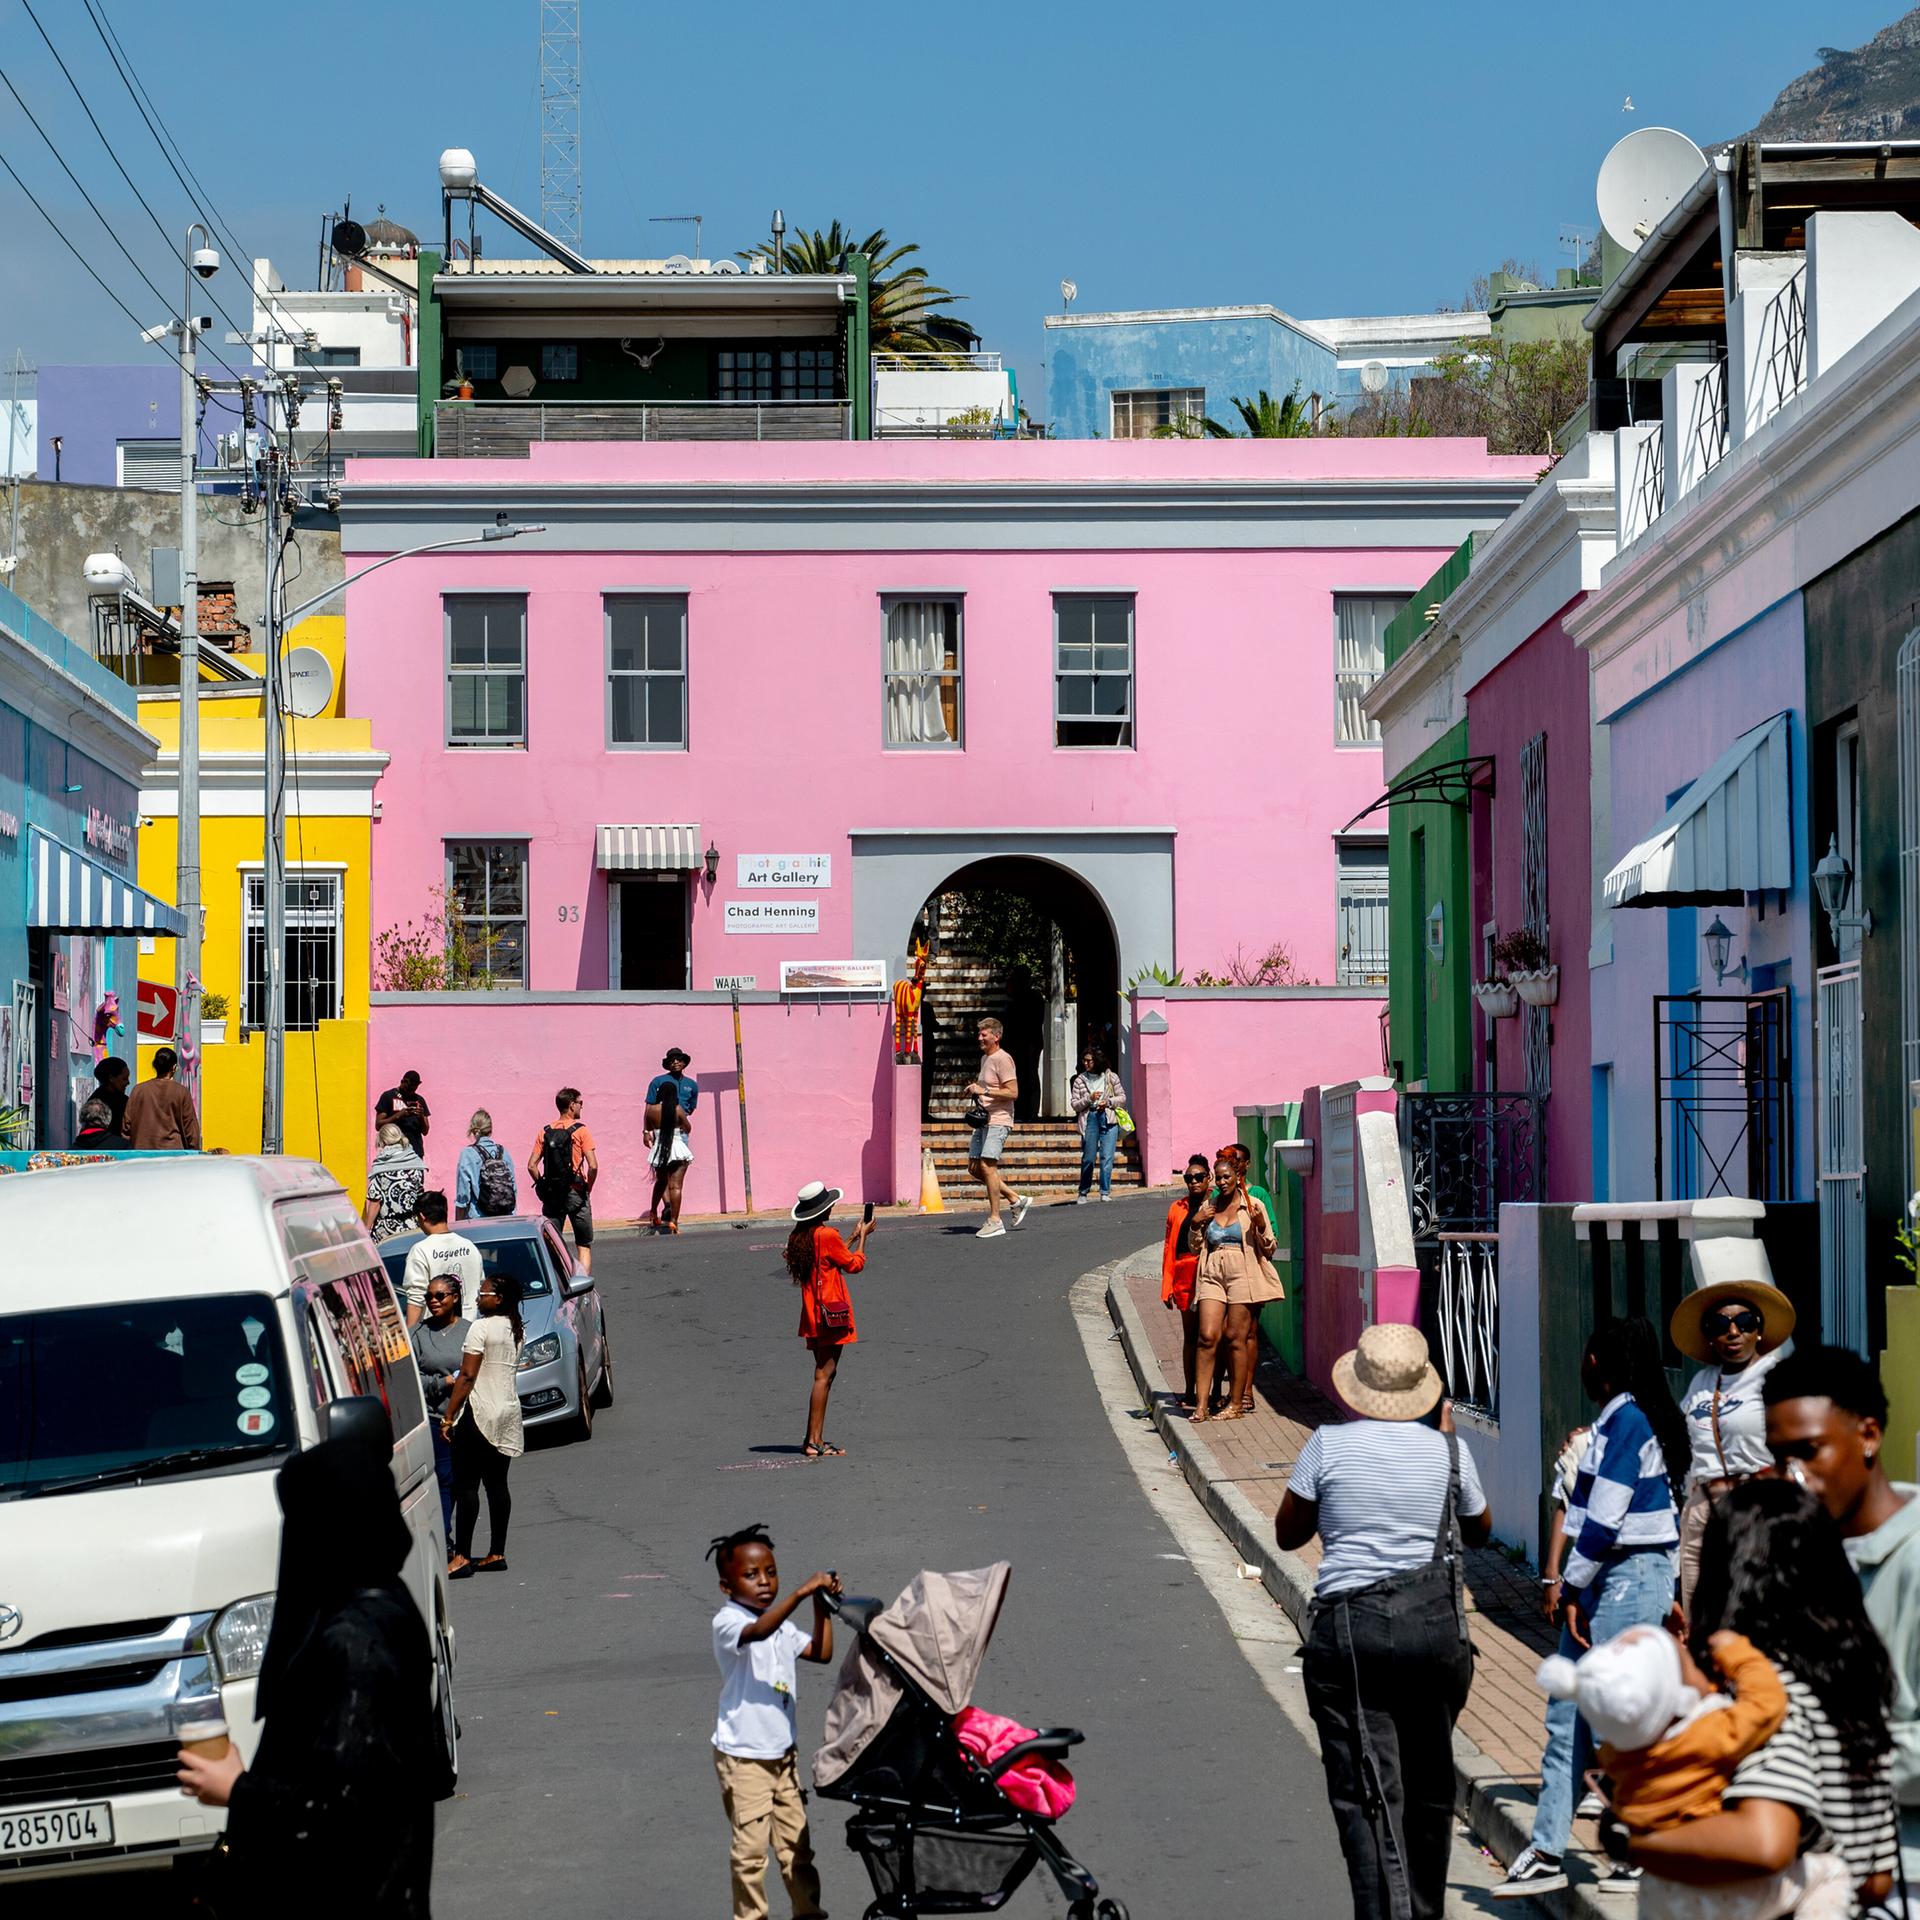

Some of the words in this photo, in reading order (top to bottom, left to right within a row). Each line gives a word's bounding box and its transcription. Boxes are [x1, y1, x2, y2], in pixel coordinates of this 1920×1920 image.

[748, 872, 767, 882] Art
[771, 872, 819, 885] Gallery
[558, 905, 580, 922] 93
[727, 907, 760, 916] Chad
[764, 907, 816, 918] Henning
[715, 977, 742, 989] WAAL
[432, 1247, 470, 1261] baguette
[1, 1809, 98, 1850] 285904
